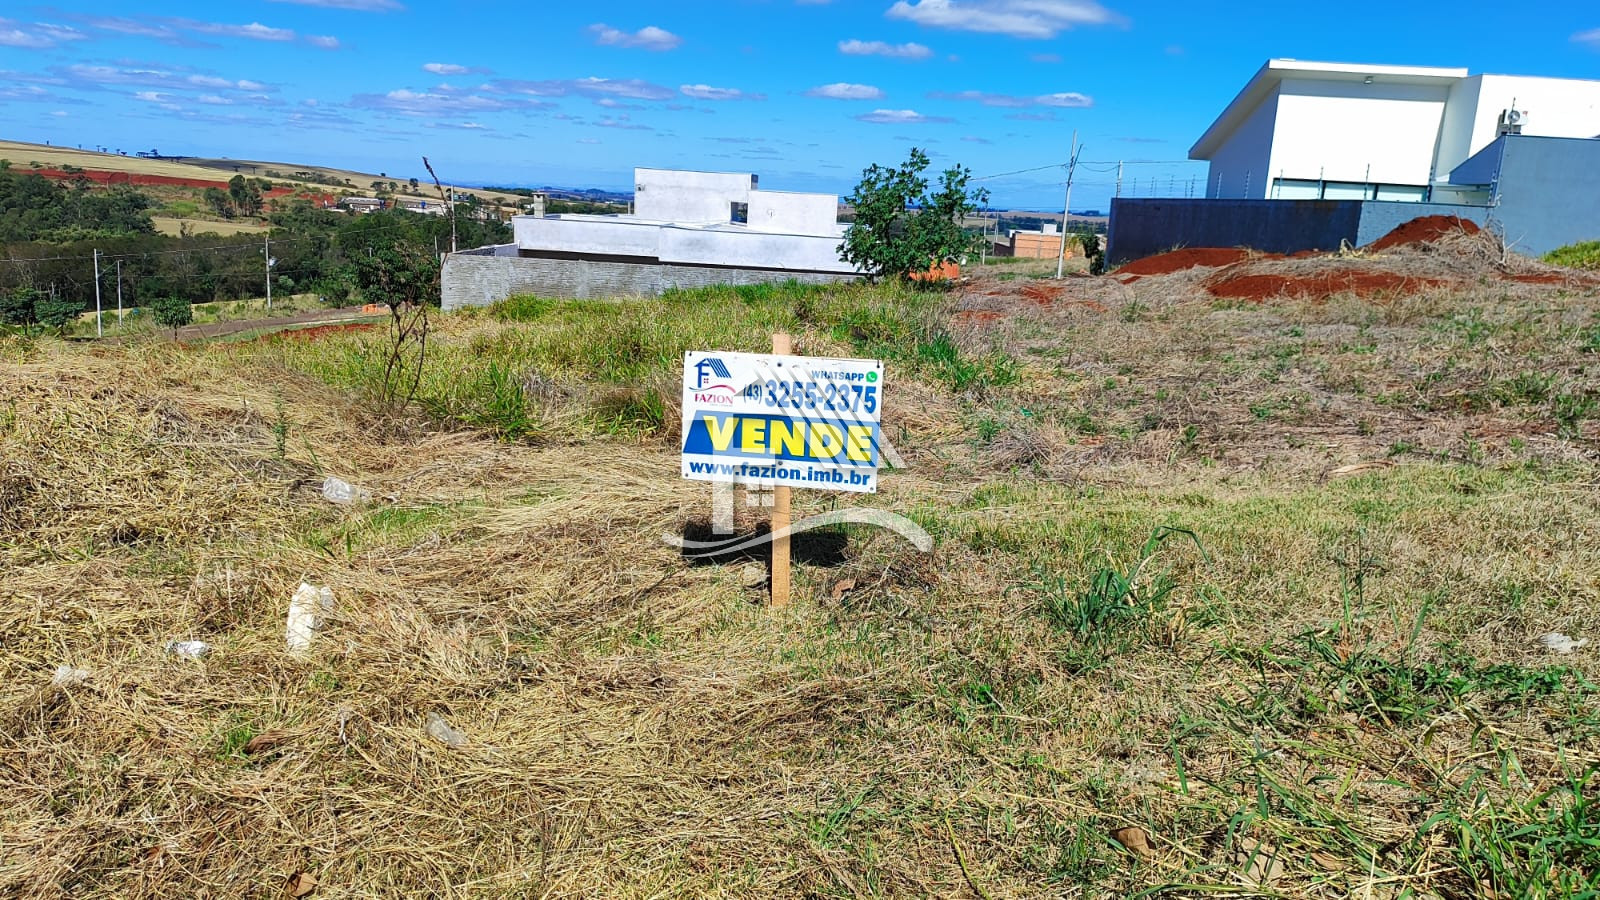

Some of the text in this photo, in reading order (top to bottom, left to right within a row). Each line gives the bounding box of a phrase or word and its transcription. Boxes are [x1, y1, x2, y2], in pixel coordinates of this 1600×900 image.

[811, 370, 864, 381] WHATSAPP
[694, 393, 734, 404] FAZION
[743, 380, 876, 414] (43) 3255-2375
[703, 415, 872, 462] VENDE
[689, 461, 870, 486] www.fazion.imb.br
